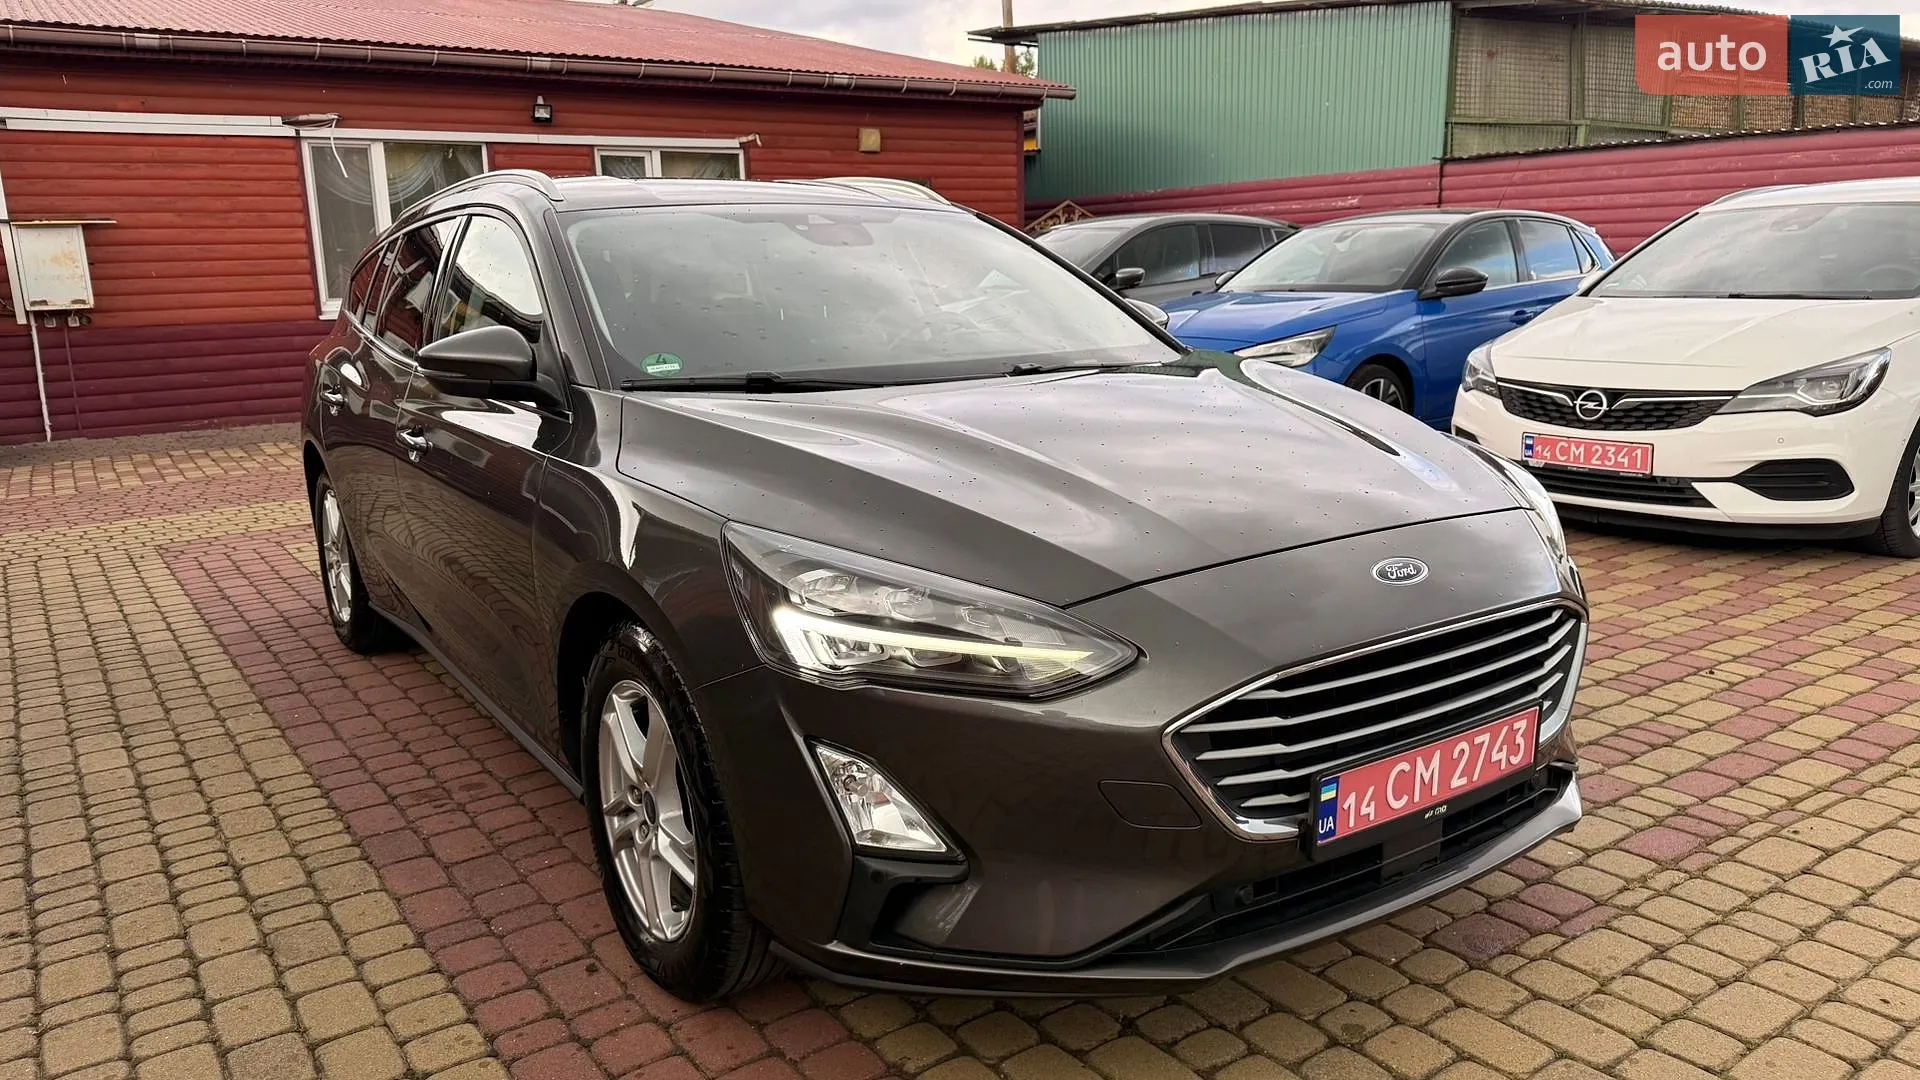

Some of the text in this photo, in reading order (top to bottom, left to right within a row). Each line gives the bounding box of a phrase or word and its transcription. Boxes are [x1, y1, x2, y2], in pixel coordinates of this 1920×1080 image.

[1535, 441, 1642, 469] 14 CM 2341
[1385, 562, 1417, 579] Ford
[1342, 718, 1528, 828] 14 CM 2743
[1318, 815, 1334, 834] UA
